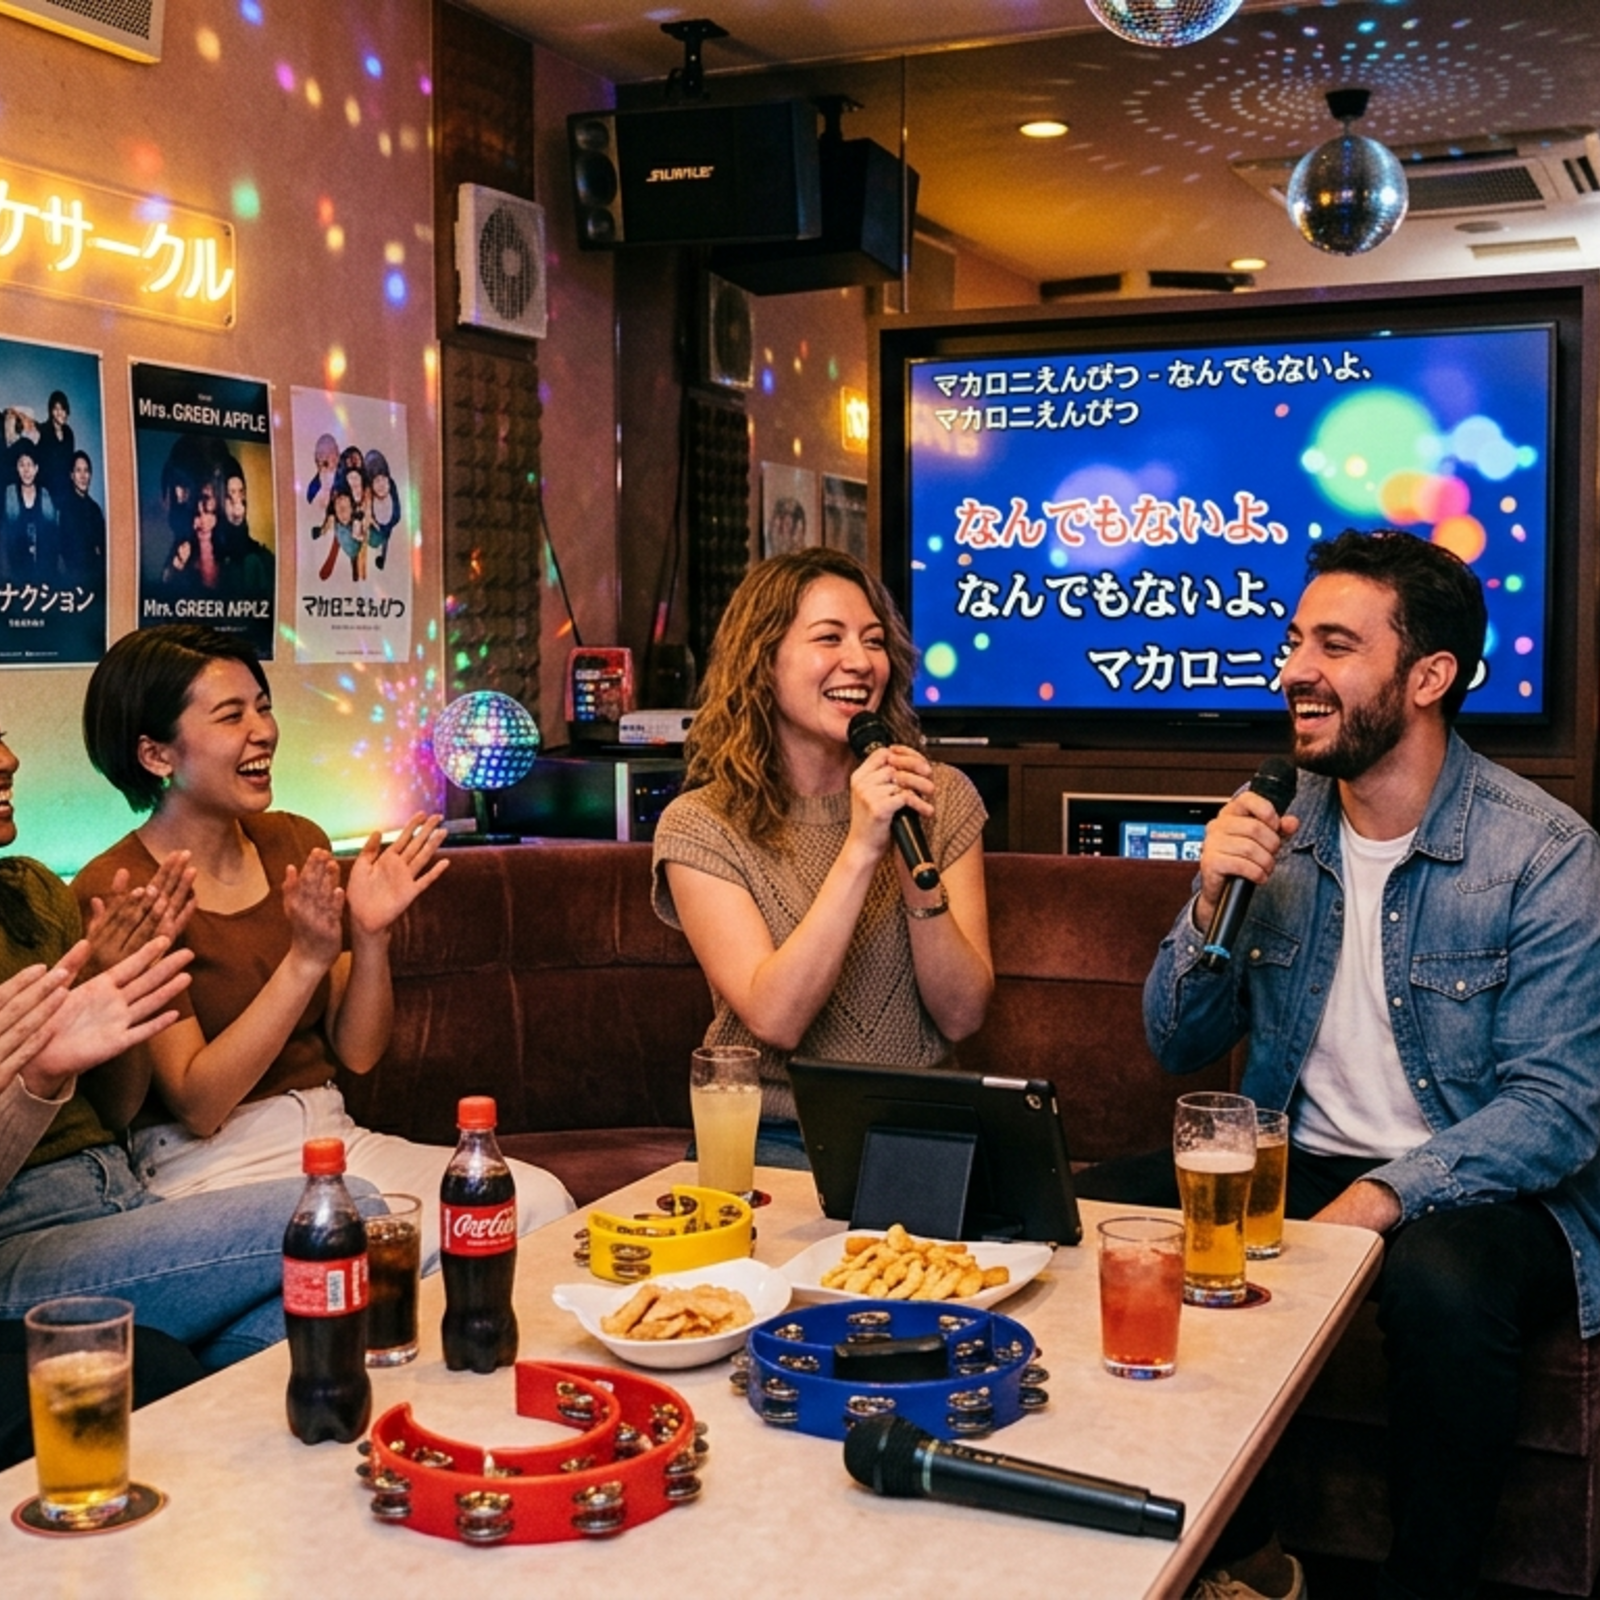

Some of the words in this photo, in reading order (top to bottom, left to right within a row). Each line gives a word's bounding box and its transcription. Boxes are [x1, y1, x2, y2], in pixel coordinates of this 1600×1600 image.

[933, 362, 1140, 398] マカロニえんぴつ
[1167, 350, 1372, 389] なんでもないよ、
[138, 398, 172, 420] Mrs.
[172, 402, 221, 426] GREEN
[223, 411, 267, 433] APPLE
[934, 398, 1140, 431] マカロニえんぴつ
[954, 490, 1289, 550] なんでもないよ、
[0, 583, 95, 613] ナクション
[956, 570, 1287, 619] なんでもないよ、
